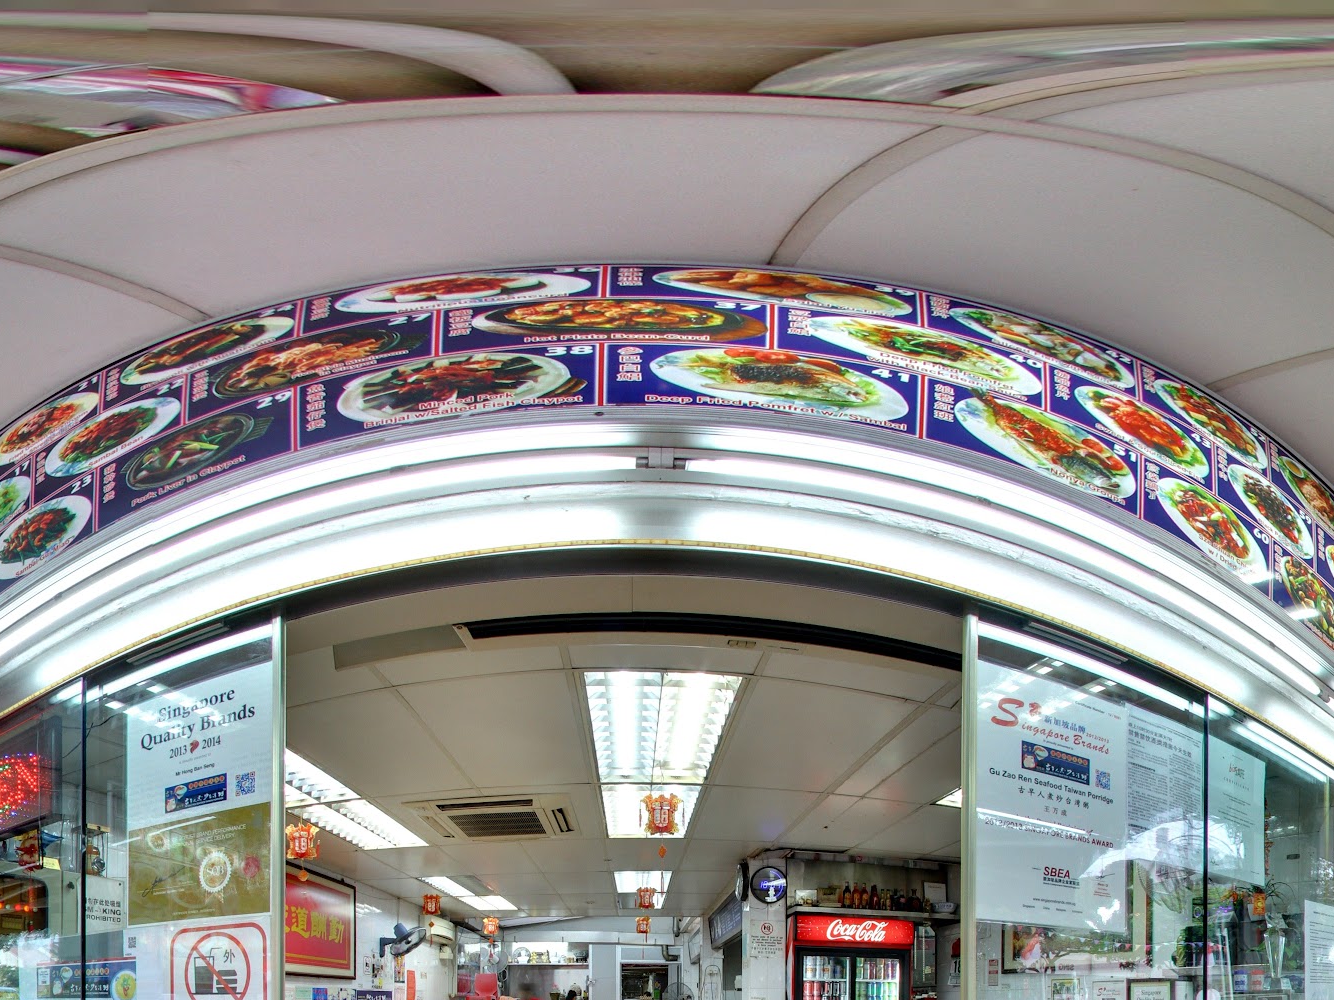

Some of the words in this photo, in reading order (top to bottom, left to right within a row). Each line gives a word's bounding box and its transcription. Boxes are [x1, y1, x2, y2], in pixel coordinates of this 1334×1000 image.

[713, 301, 762, 311] 37
[388, 312, 433, 326] 27
[523, 335, 556, 343] Hot
[560, 334, 607, 342] Plate
[545, 345, 595, 356] 38
[1106, 349, 1133, 364] 42
[1009, 353, 1042, 369] 40
[77, 376, 98, 391] 21
[871, 367, 911, 383] 41
[157, 378, 184, 395] 22
[256, 391, 292, 409] 29
[418, 395, 475, 410] Minced
[478, 391, 516, 403] Pork
[363, 413, 410, 429] Brinjal
[481, 399, 516, 411] Fish
[520, 394, 584, 408] Claypot
[645, 394, 693, 405] Deep
[696, 395, 743, 407] Fried
[747, 400, 817, 416] Pomfret
[848, 412, 908, 431] Sambal
[1191, 432, 1212, 449] 43
[88, 449, 118, 466] Sambal
[120, 435, 144, 451] Bean
[1114, 444, 1137, 462] 51
[15, 460, 29, 476] 17
[70, 475, 92, 494] 23
[131, 489, 157, 507] Pork
[158, 477, 186, 496] Liver
[186, 471, 198, 484] in
[199, 454, 246, 478] Claypot
[1050, 467, 1086, 487] Nonya
[1253, 528, 1270, 545] 60
[157, 689, 235, 723] Singapore
[140, 723, 196, 751] Quality
[199, 704, 256, 732] Brands
[991, 697, 1070, 743] Singapore
[1073, 733, 1110, 755] Brands
[169, 744, 188, 759] 2013
[202, 735, 222, 750] 2014
[989, 767, 1001, 777] Gu
[1002, 770, 1016, 780] Zao
[1018, 774, 1032, 784] Ren
[1034, 778, 1063, 792] Seafood
[1064, 785, 1087, 798] Taiwan
[1088, 792, 1114, 805] Porridge
[1091, 838, 1114, 849] AWARD
[1043, 866, 1071, 880] SBEA
[87, 914, 121, 923] ROHIBITED
[285, 905, 345, 944] 道酬勤
[826, 919, 889, 942] Coca-Cola
[223, 948, 236, 964] 外
